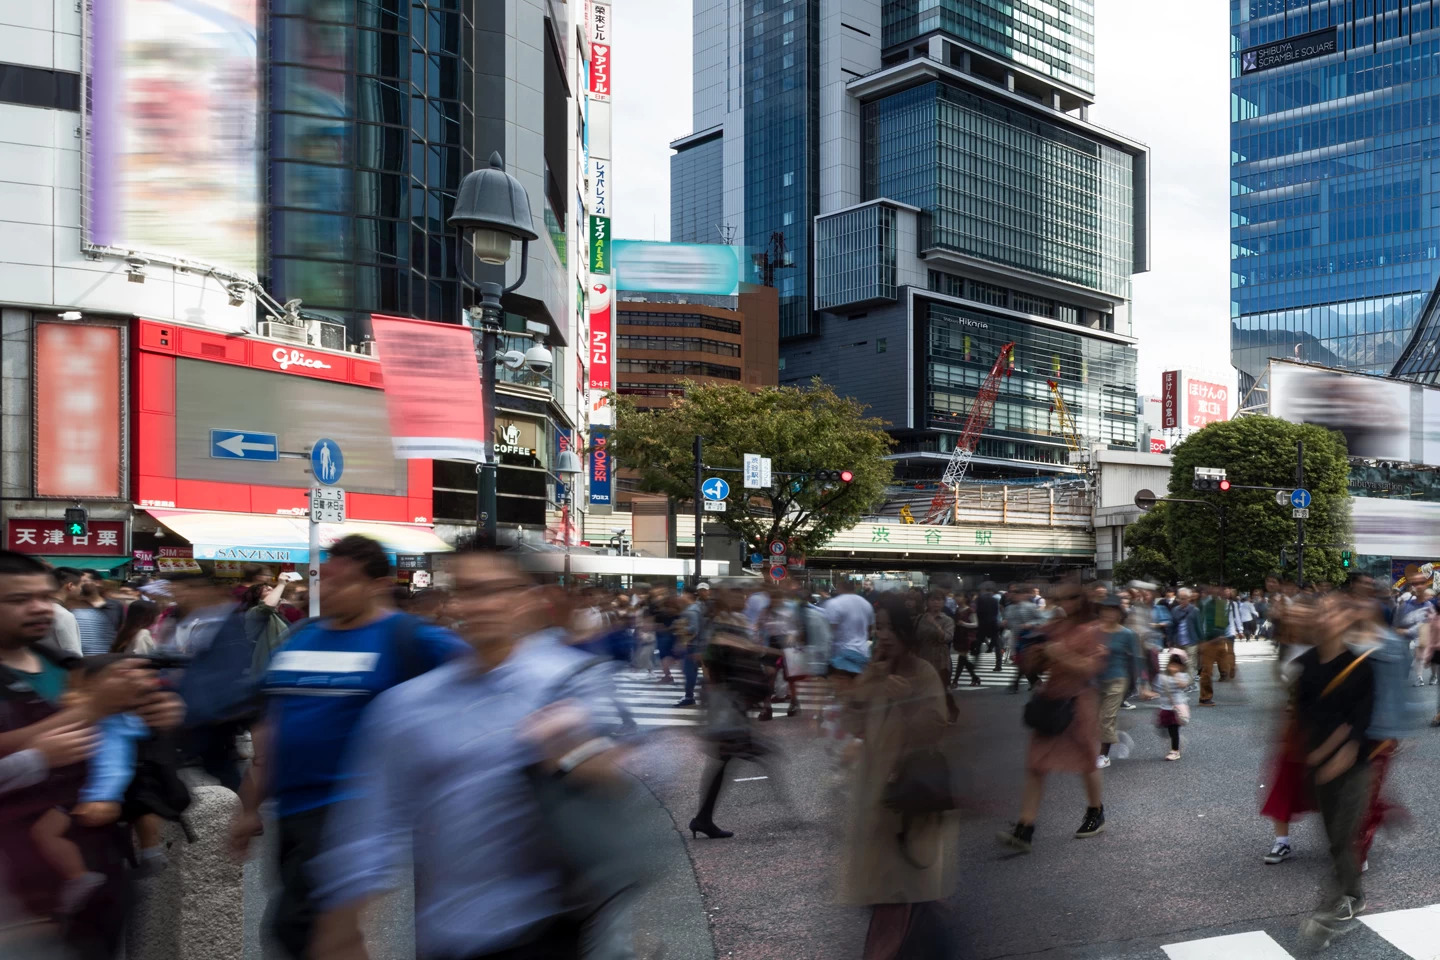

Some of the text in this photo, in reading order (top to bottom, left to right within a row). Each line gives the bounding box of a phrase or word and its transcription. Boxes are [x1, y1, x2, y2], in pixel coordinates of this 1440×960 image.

[1258, 42, 1293, 59] SHIBUYA
[1258, 41, 1335, 68] SCRAMBLE SQUARE
[595, 55, 608, 93] アイフル
[596, 161, 605, 214] レオパレス21
[958, 317, 988, 329] Hikarie
[593, 330, 608, 364] アコム
[272, 348, 331, 370] Glico
[1165, 373, 1174, 426] ほけんの窓口
[1189, 383, 1227, 401] ほけんの
[494, 444, 530, 456] COFFEE
[1348, 480, 1403, 491] hibuya station
[315, 489, 322, 498] 15
[336, 491, 342, 500] 5
[315, 510, 322, 520] 12
[337, 512, 342, 521] 5
[872, 526, 993, 546] 渋谷駅
[135, 553, 153, 562] SIM
[160, 548, 177, 557] SIM
[218, 549, 290, 561] SANZENRI
